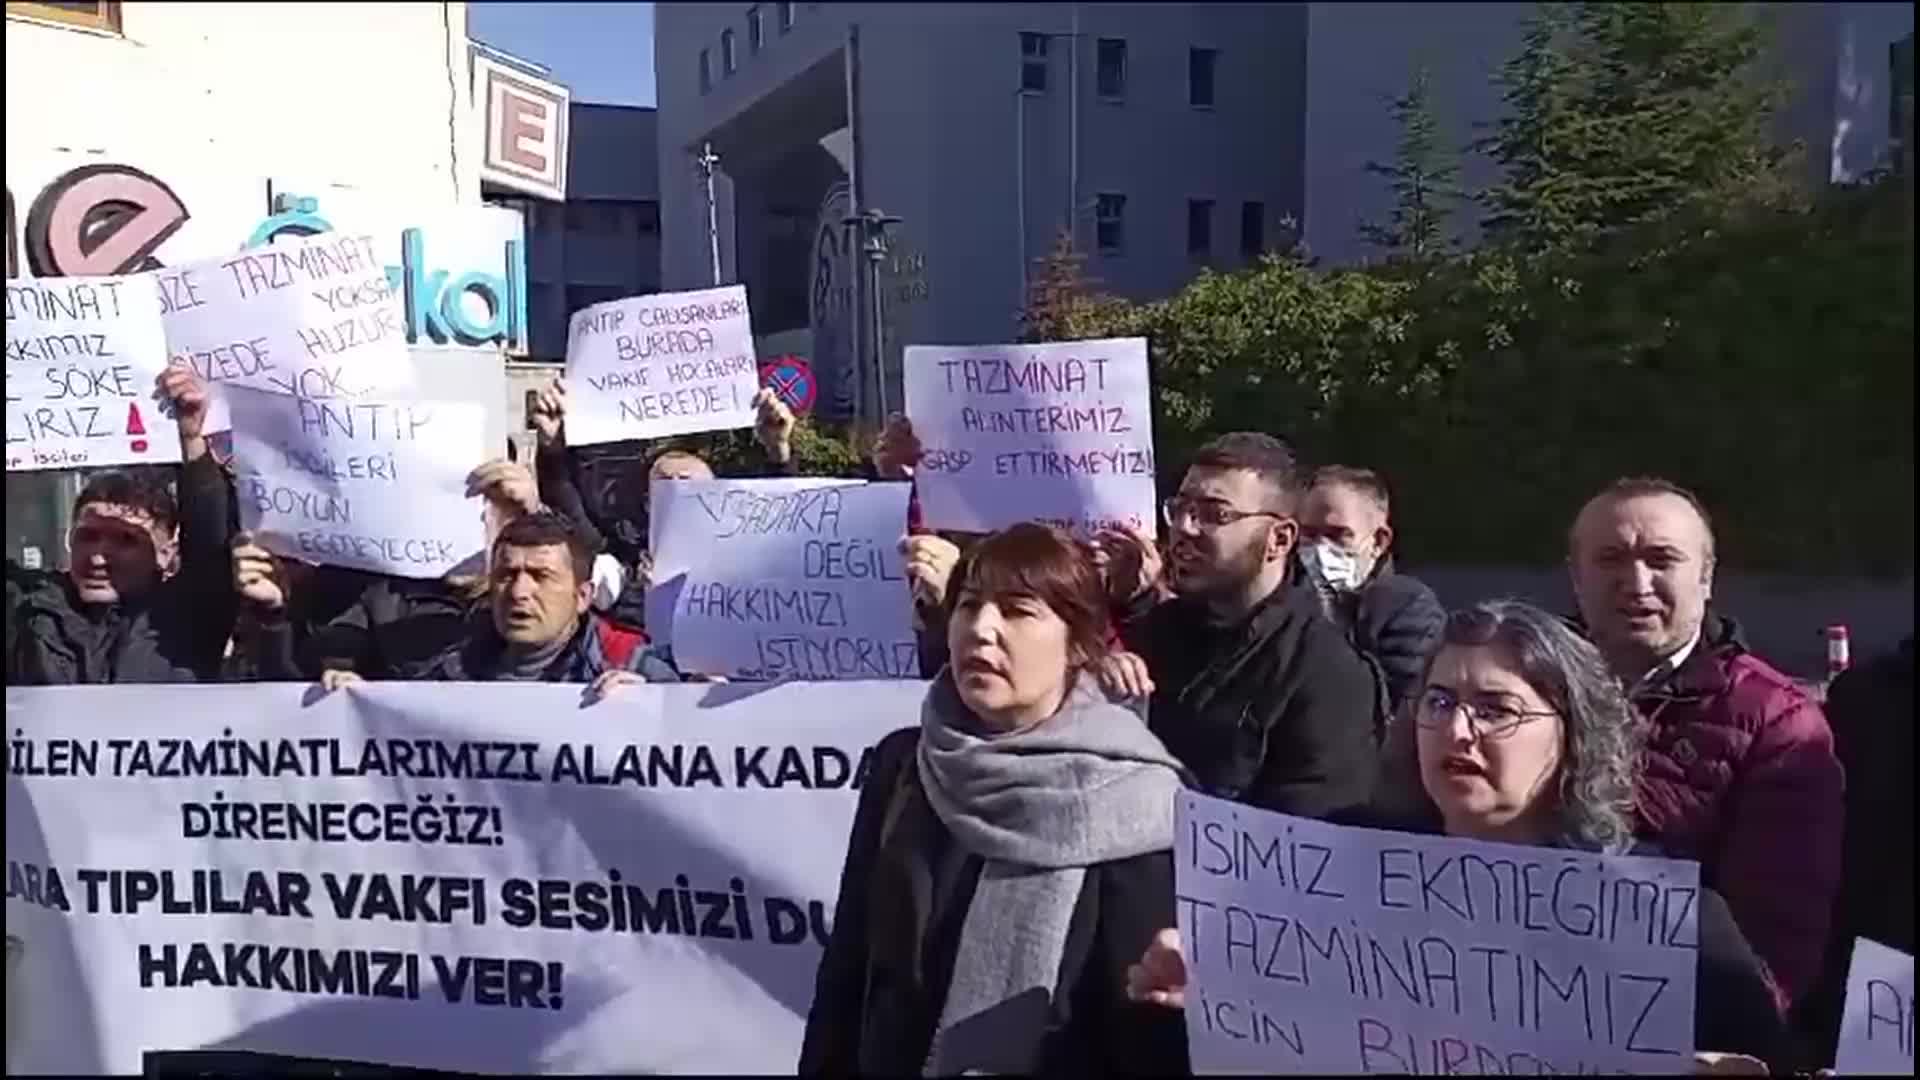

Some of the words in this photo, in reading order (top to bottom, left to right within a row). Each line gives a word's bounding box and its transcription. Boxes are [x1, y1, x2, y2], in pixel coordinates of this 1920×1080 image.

[500, 90, 546, 173] E
[221, 236, 378, 300] TAZMİNAT
[6, 281, 123, 321] MİNAT
[616, 318, 714, 362] BURADA
[44, 363, 138, 399] SÖKE
[587, 367, 650, 392] VAKIF
[937, 355, 1109, 395] TAZMİNAT
[250, 478, 350, 523] BOYUN
[803, 538, 905, 581] DEĞİL
[687, 582, 848, 627] HAKKIMIZI
[6, 728, 99, 777] İLEN
[108, 728, 541, 782] TAZMİNATLARIMIZI
[550, 743, 723, 787] ALANA
[181, 791, 505, 846] DİRENECEĞİZ!
[77, 869, 313, 918] TIPLILAR
[321, 872, 487, 927] VAKFI
[500, 868, 753, 941] SESİMİZİ
[1379, 848, 1698, 950] EKMEĞİMİZ
[138, 942, 419, 1001] HAKKIMIZI
[431, 954, 564, 1012] VER!
[1175, 894, 1682, 1057] TAZMİNATIMIZ
